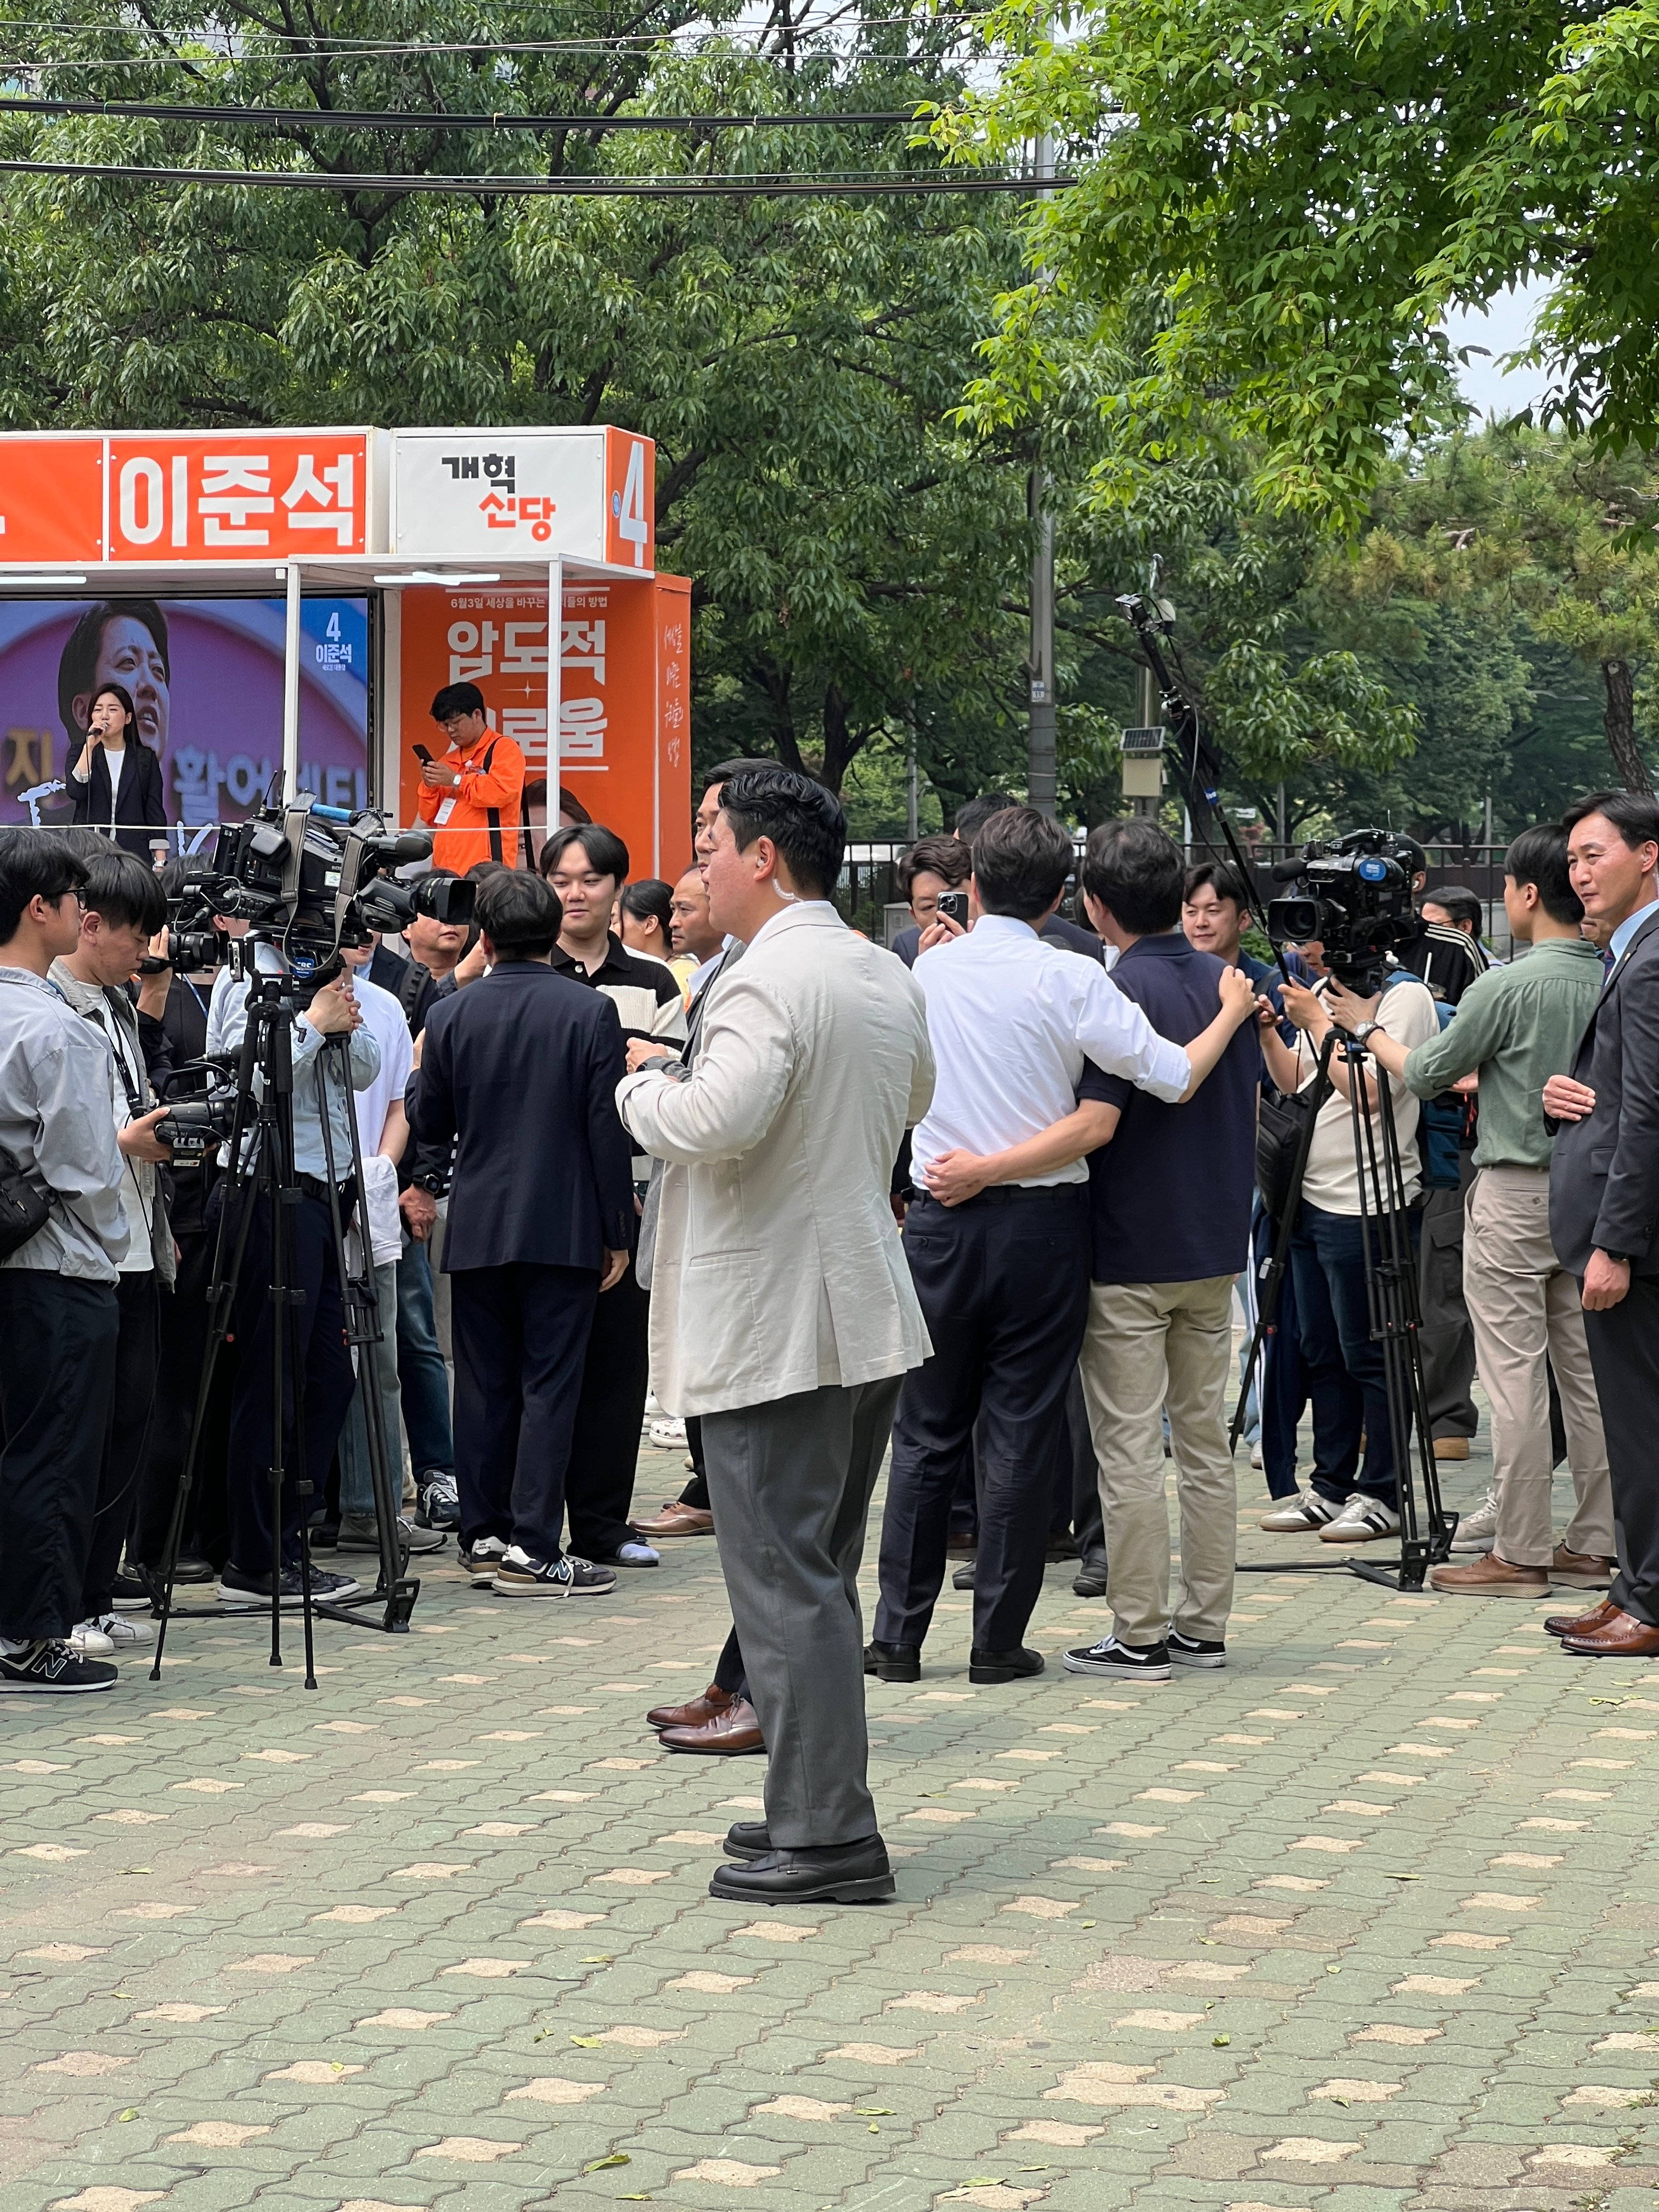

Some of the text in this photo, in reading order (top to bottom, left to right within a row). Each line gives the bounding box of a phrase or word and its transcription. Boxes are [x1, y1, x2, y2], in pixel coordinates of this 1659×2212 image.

[441, 453, 515, 494] 개혁
[120, 454, 353, 546] 이준석
[479, 492, 556, 541] 신당
[619, 441, 647, 567] 4
[450, 597, 483, 608] 6월3일
[486, 596, 514, 608] 세상을
[517, 596, 545, 608] 바꾸는
[588, 596, 607, 607] 방법
[326, 612, 341, 642] 4
[315, 644, 352, 663] 이준석
[447, 619, 606, 687] 압도적
[446, 697, 607, 757] 로움
[31, 1651, 67, 1679] N
